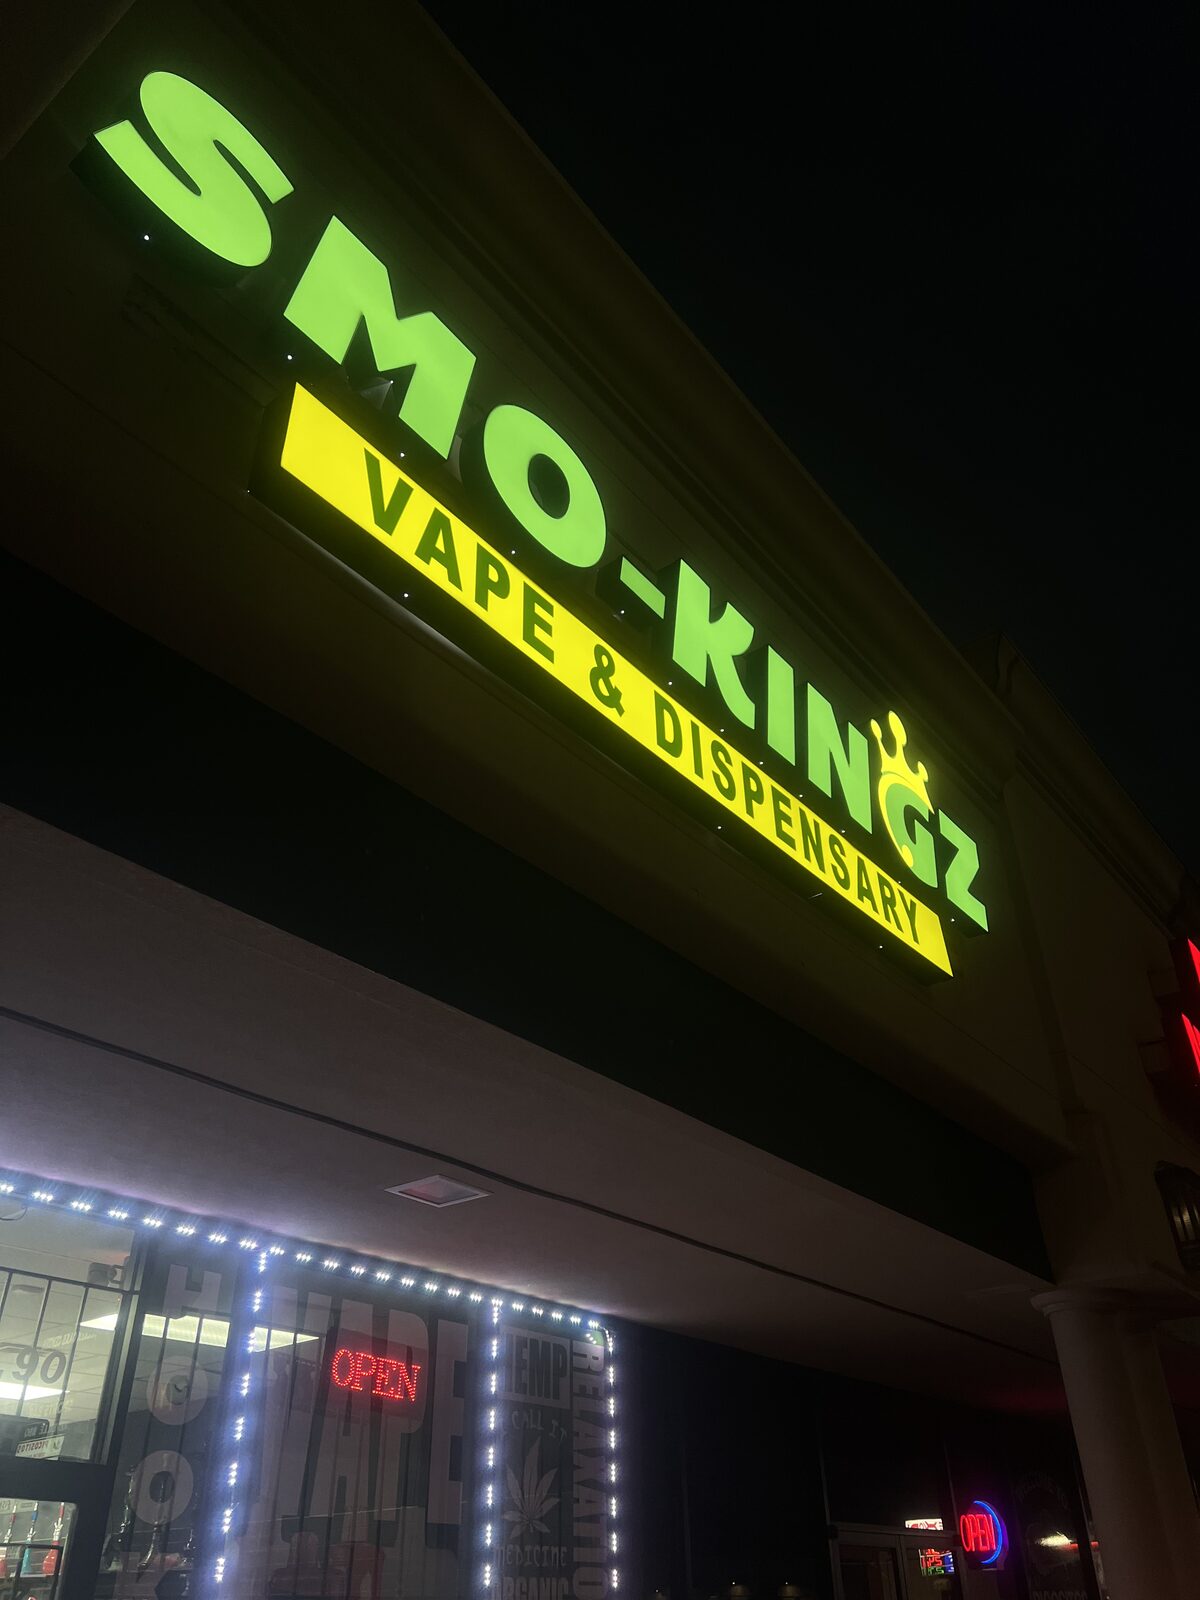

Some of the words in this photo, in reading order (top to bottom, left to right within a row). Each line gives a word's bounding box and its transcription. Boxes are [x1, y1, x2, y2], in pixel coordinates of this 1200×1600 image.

[94, 69, 988, 933] SMO-KINGZ
[365, 448, 556, 666] VAPE
[590, 643, 624, 717] &
[653, 689, 922, 945] DISPENSARY
[0, 1346, 67, 1384] 90
[331, 1348, 422, 1403] OPEN
[960, 1514, 996, 1552] OPEN
